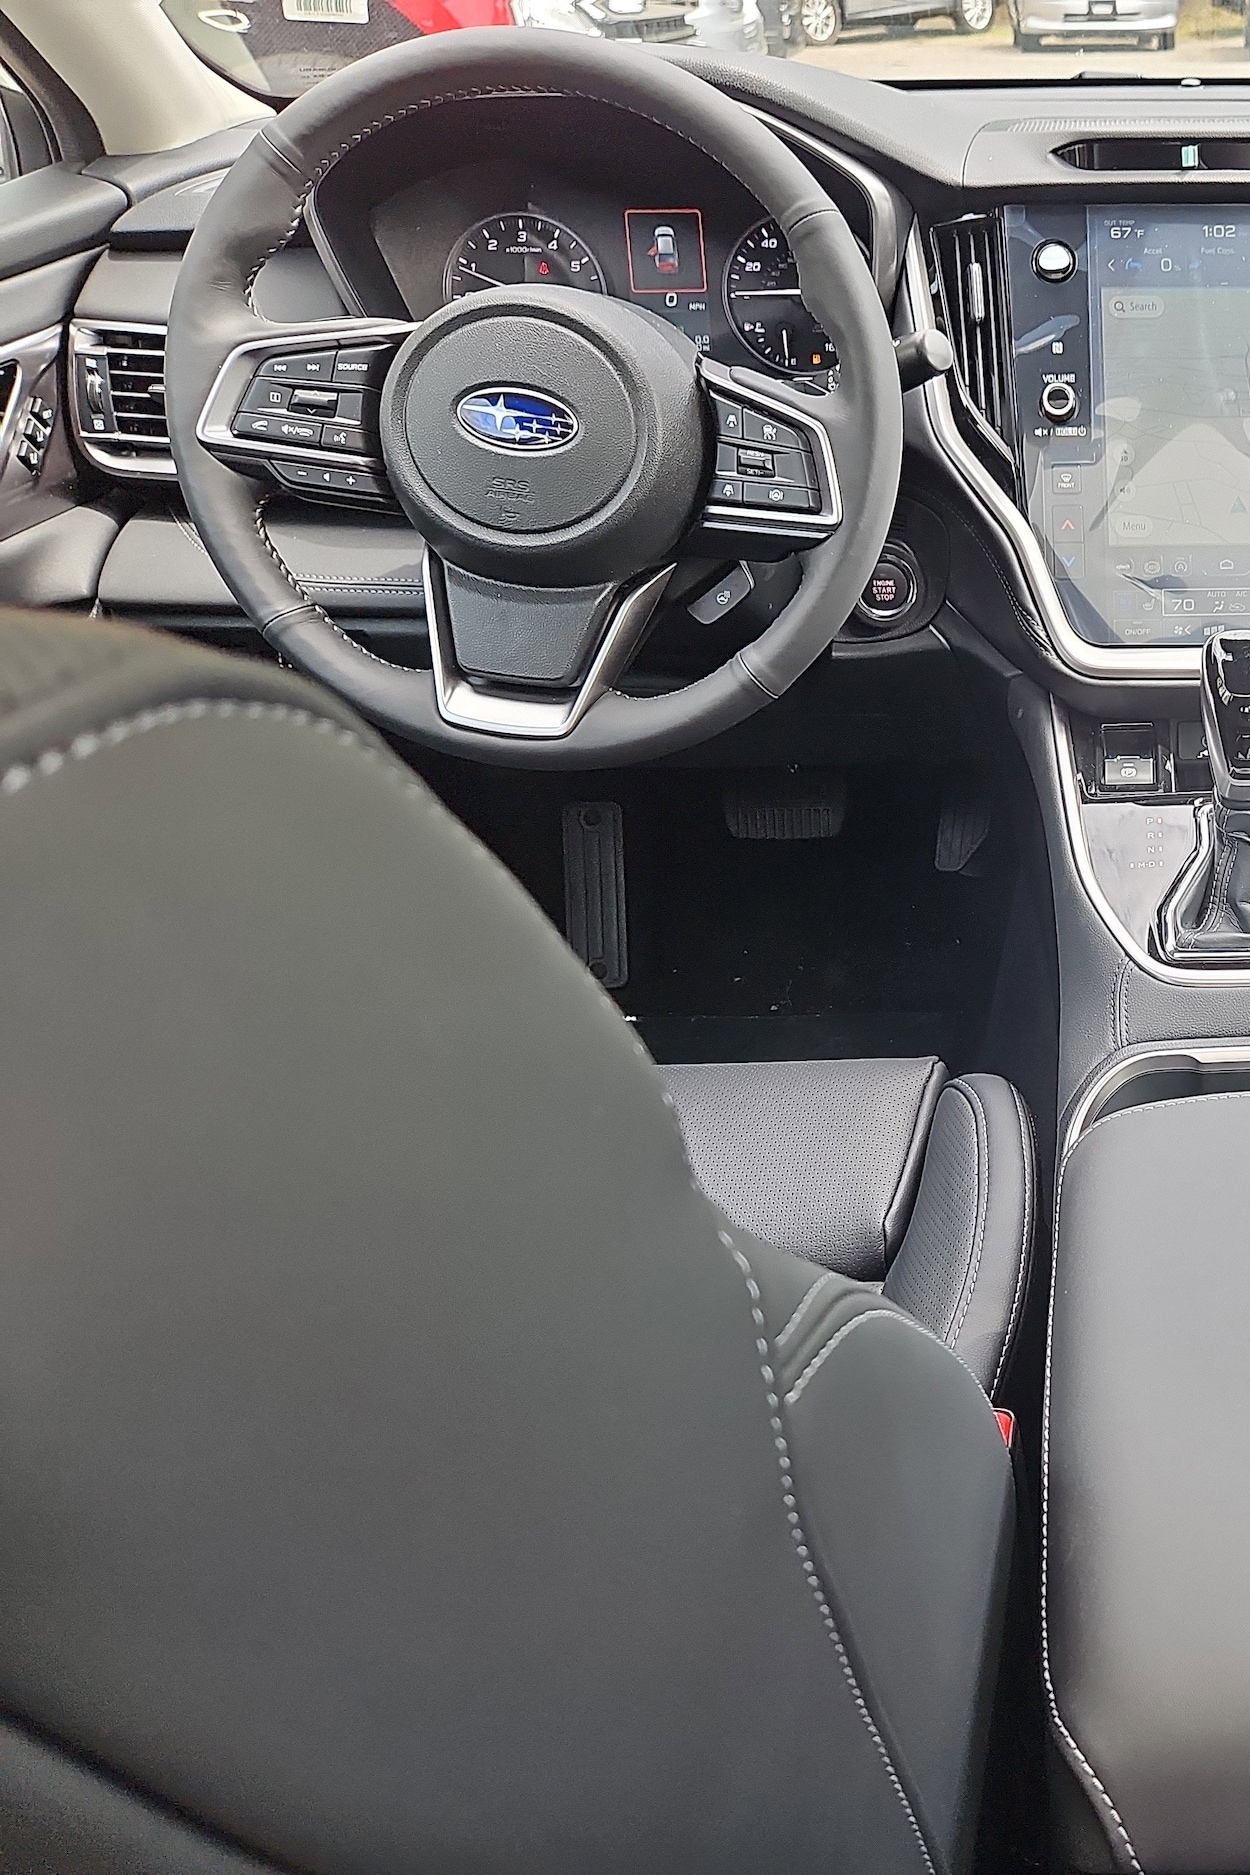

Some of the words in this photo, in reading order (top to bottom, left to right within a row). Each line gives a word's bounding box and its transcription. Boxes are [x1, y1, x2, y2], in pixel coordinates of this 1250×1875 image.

[517, 231, 527, 242] 3
[1110, 227, 1132, 239] 67
[1202, 225, 1236, 238] 1:02
[487, 239, 498, 250] 2
[548, 240, 558, 250] 4
[761, 238, 778, 248] 40
[1200, 247, 1216, 255] Fuel
[470, 263, 477, 272] 1
[570, 261, 581, 272] 5
[745, 262, 762, 272] 20
[1160, 258, 1172, 272] 0
[665, 292, 678, 308] 0
[689, 302, 706, 311] MPH
[1129, 301, 1157, 312] Search
[694, 335, 710, 344] 0.0
[337, 362, 369, 371] SOURCE
[1042, 374, 1076, 383] VOLUME
[492, 476, 530, 492] SRS
[1122, 522, 1146, 531] Menu
[1207, 590, 1226, 598] AUTO
[1236, 590, 1248, 598] A/C
[1171, 598, 1195, 612] 70
[1124, 628, 1151, 636] ON/OFF
